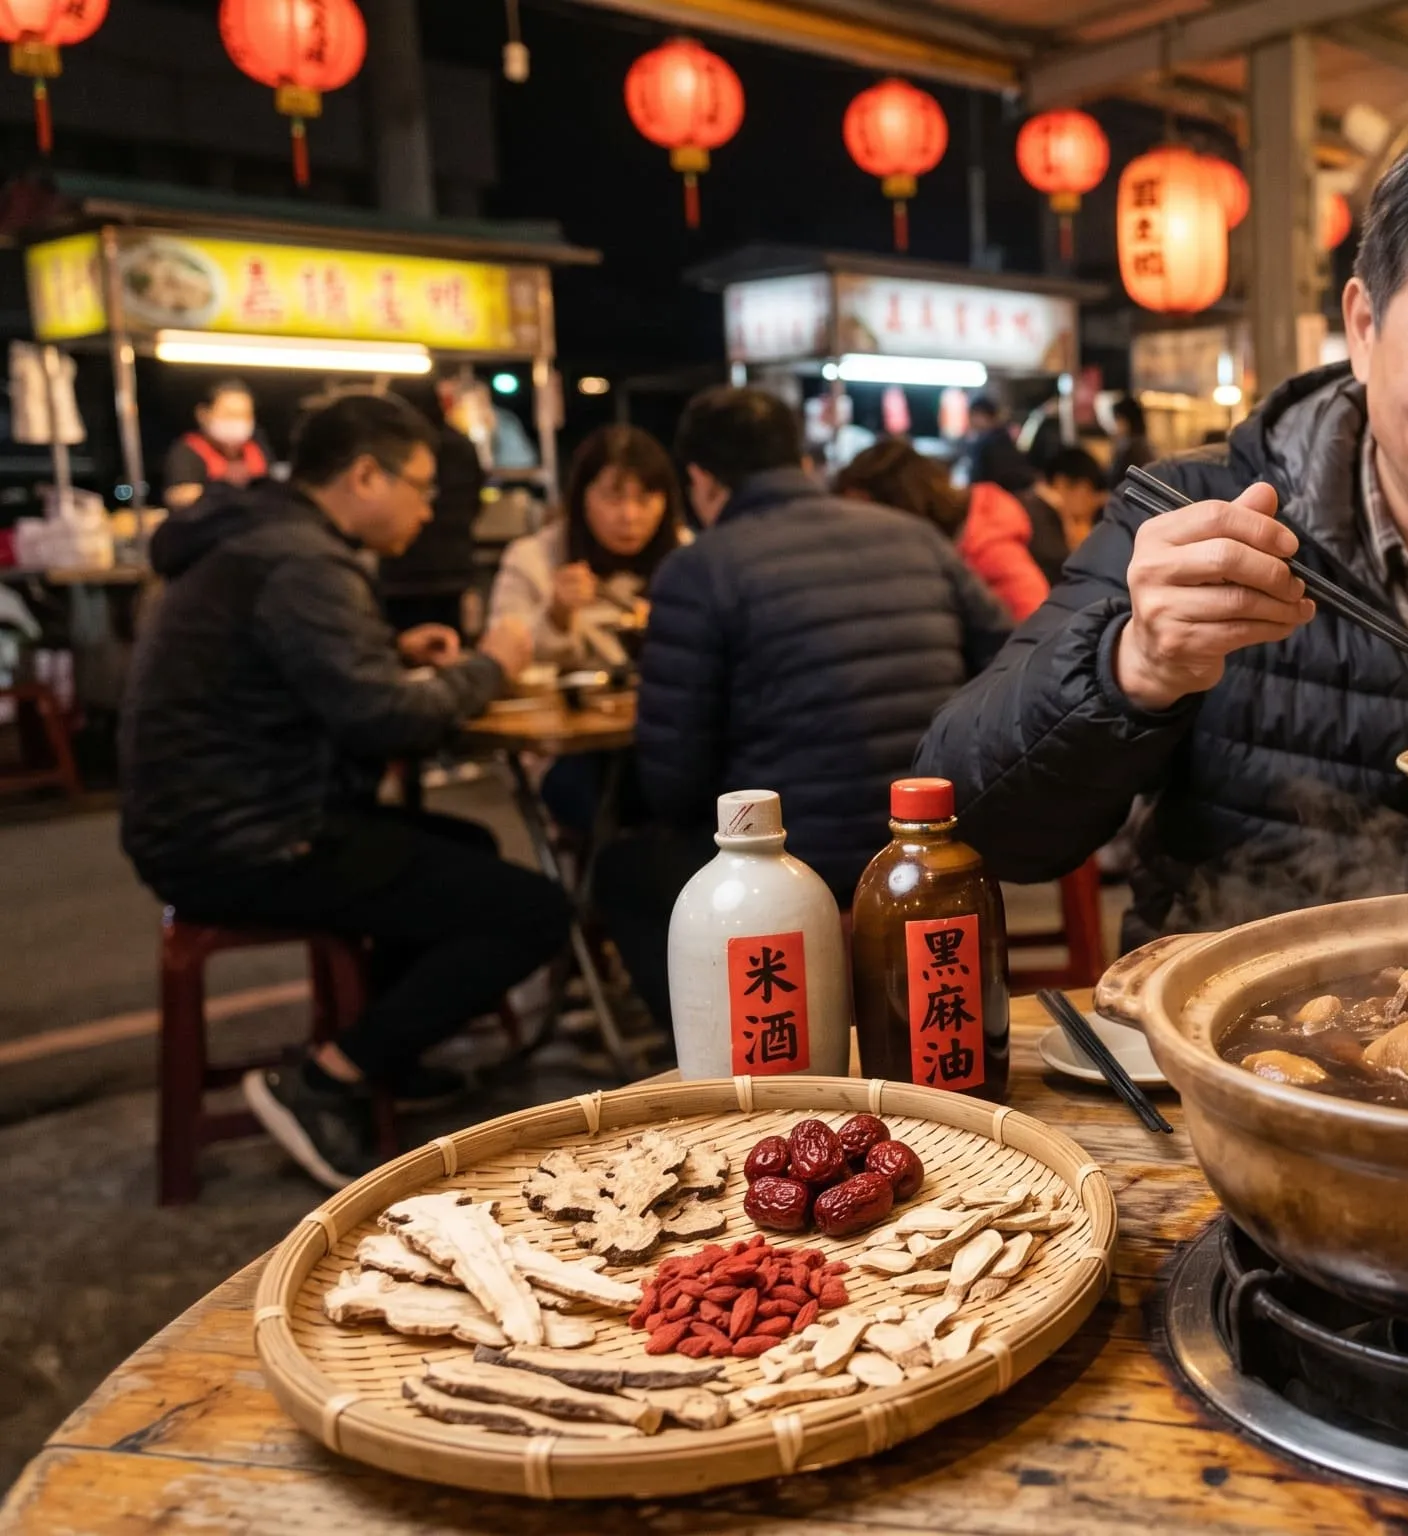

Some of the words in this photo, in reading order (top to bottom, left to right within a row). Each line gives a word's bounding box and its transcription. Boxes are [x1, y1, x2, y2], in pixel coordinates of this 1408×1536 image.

[744, 947, 798, 1064] 米酒
[920, 928, 977, 1084] 黑麻油
